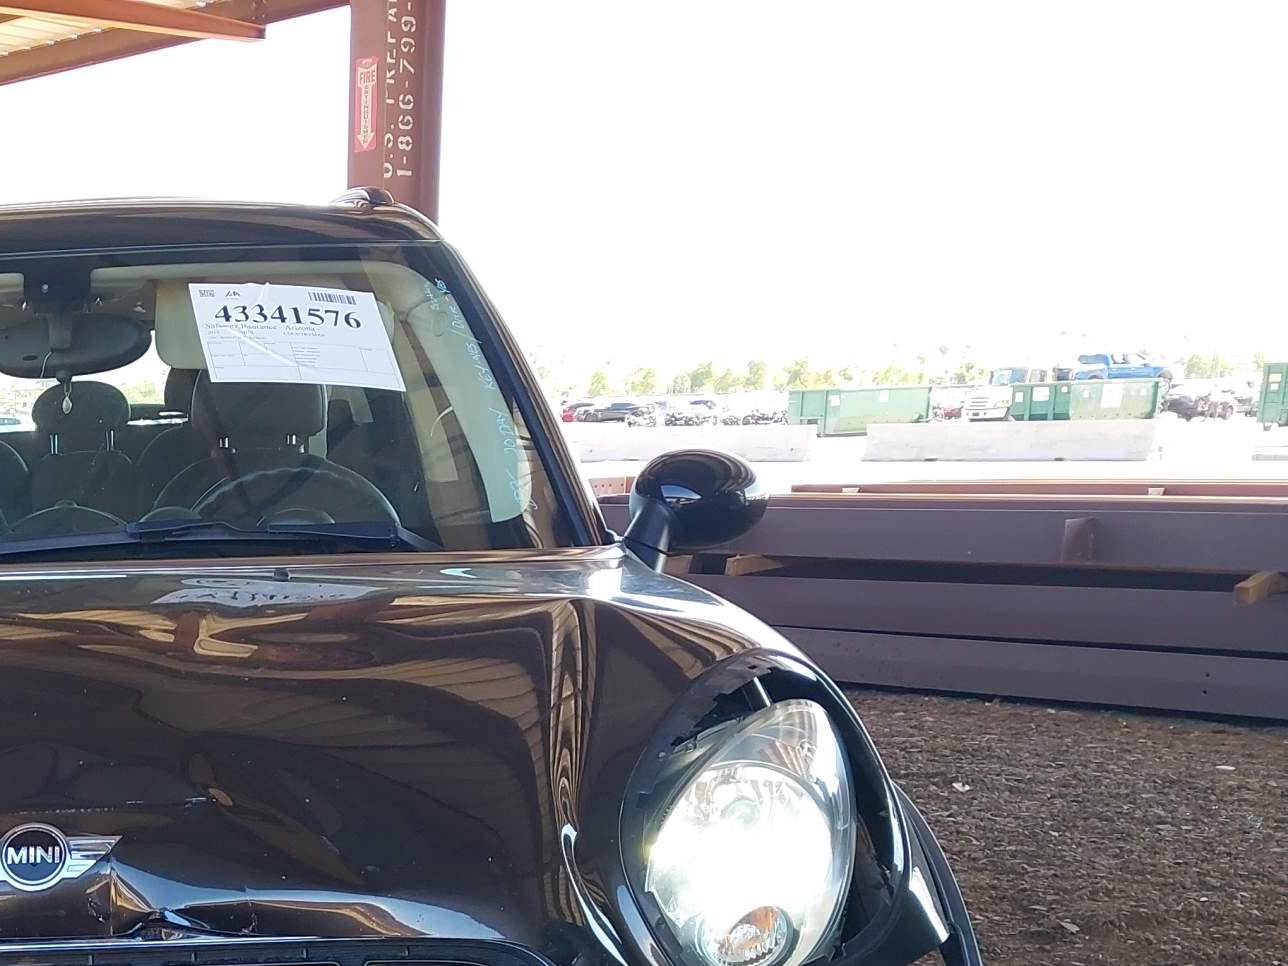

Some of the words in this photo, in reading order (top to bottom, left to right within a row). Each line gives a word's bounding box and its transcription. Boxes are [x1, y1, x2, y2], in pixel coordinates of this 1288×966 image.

[359, 70, 376, 84] FIRE
[214, 303, 362, 329] 43341576
[6, 845, 61, 865] MINI
